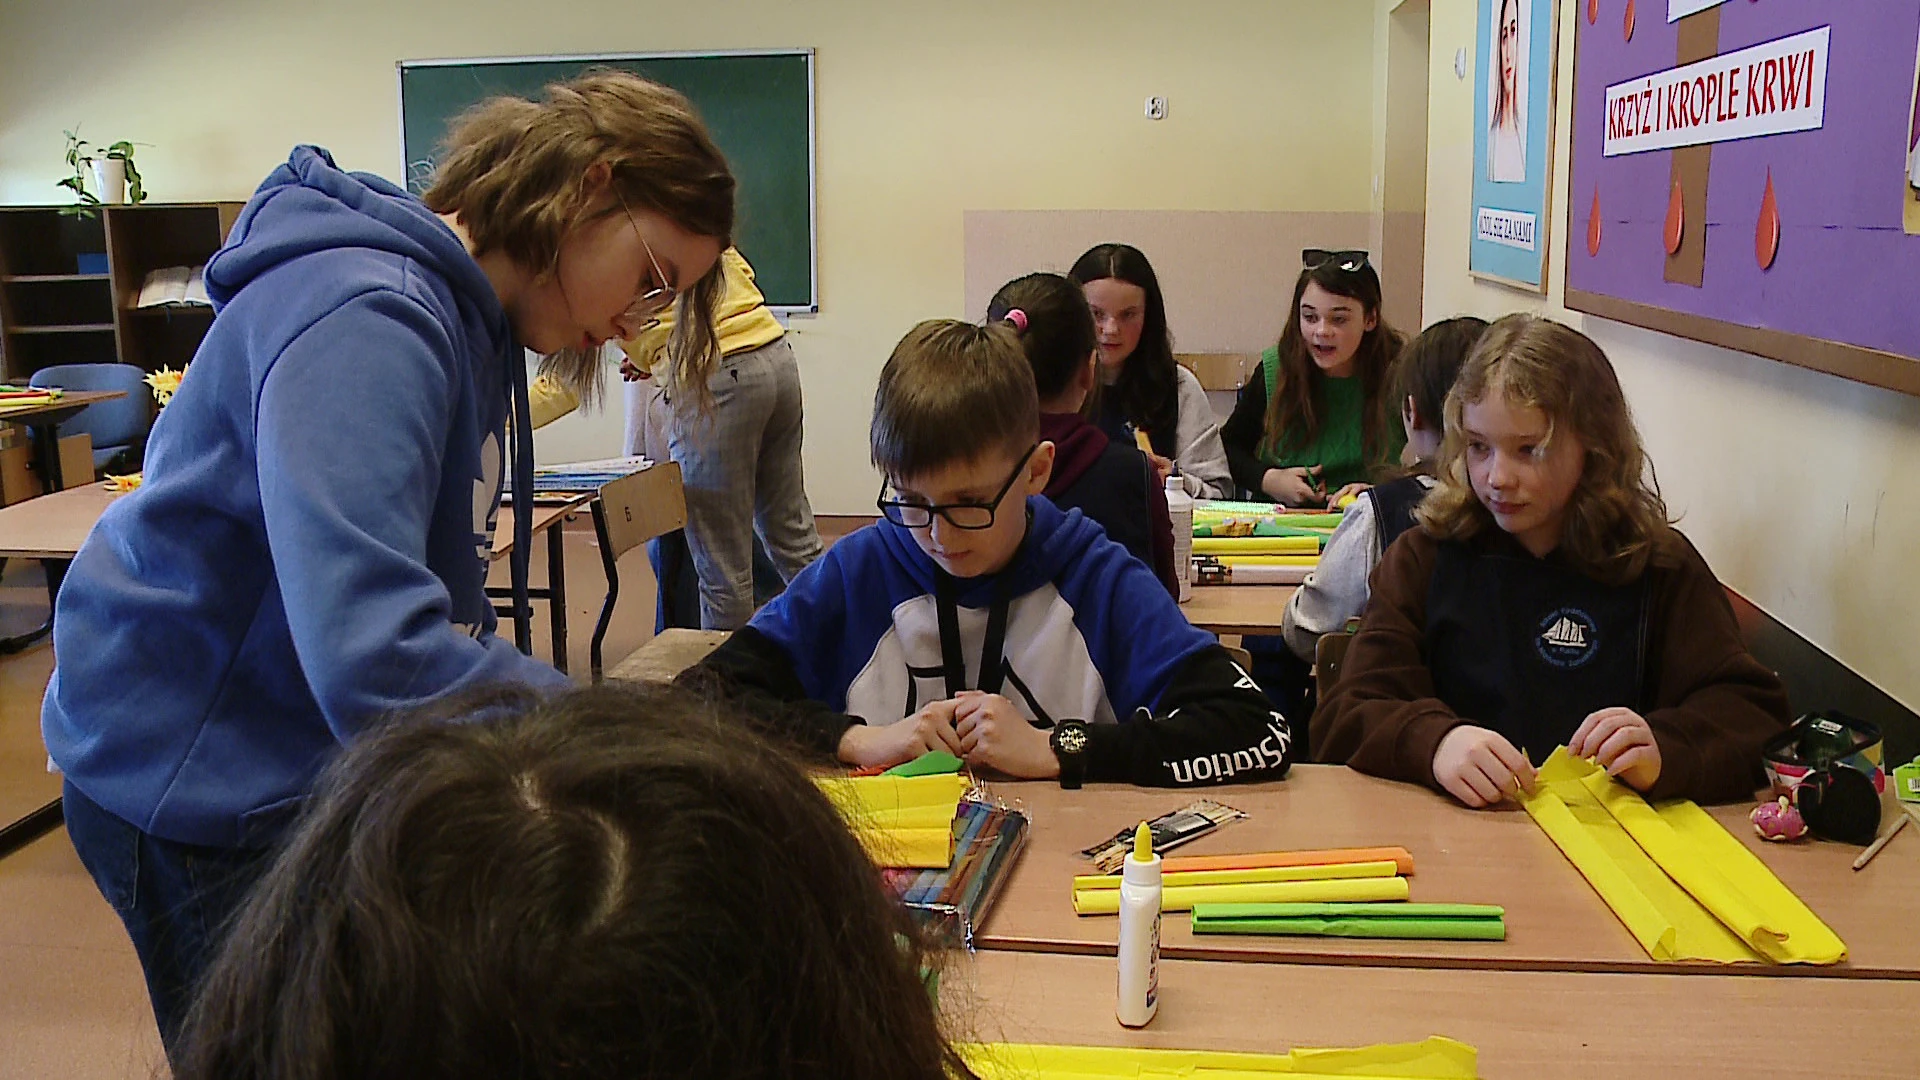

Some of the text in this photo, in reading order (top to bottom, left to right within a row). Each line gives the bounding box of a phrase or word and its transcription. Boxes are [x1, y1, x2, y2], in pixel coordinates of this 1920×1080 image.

[1608, 49, 1815, 141] KRZYŻ I KROPLE KRWI
